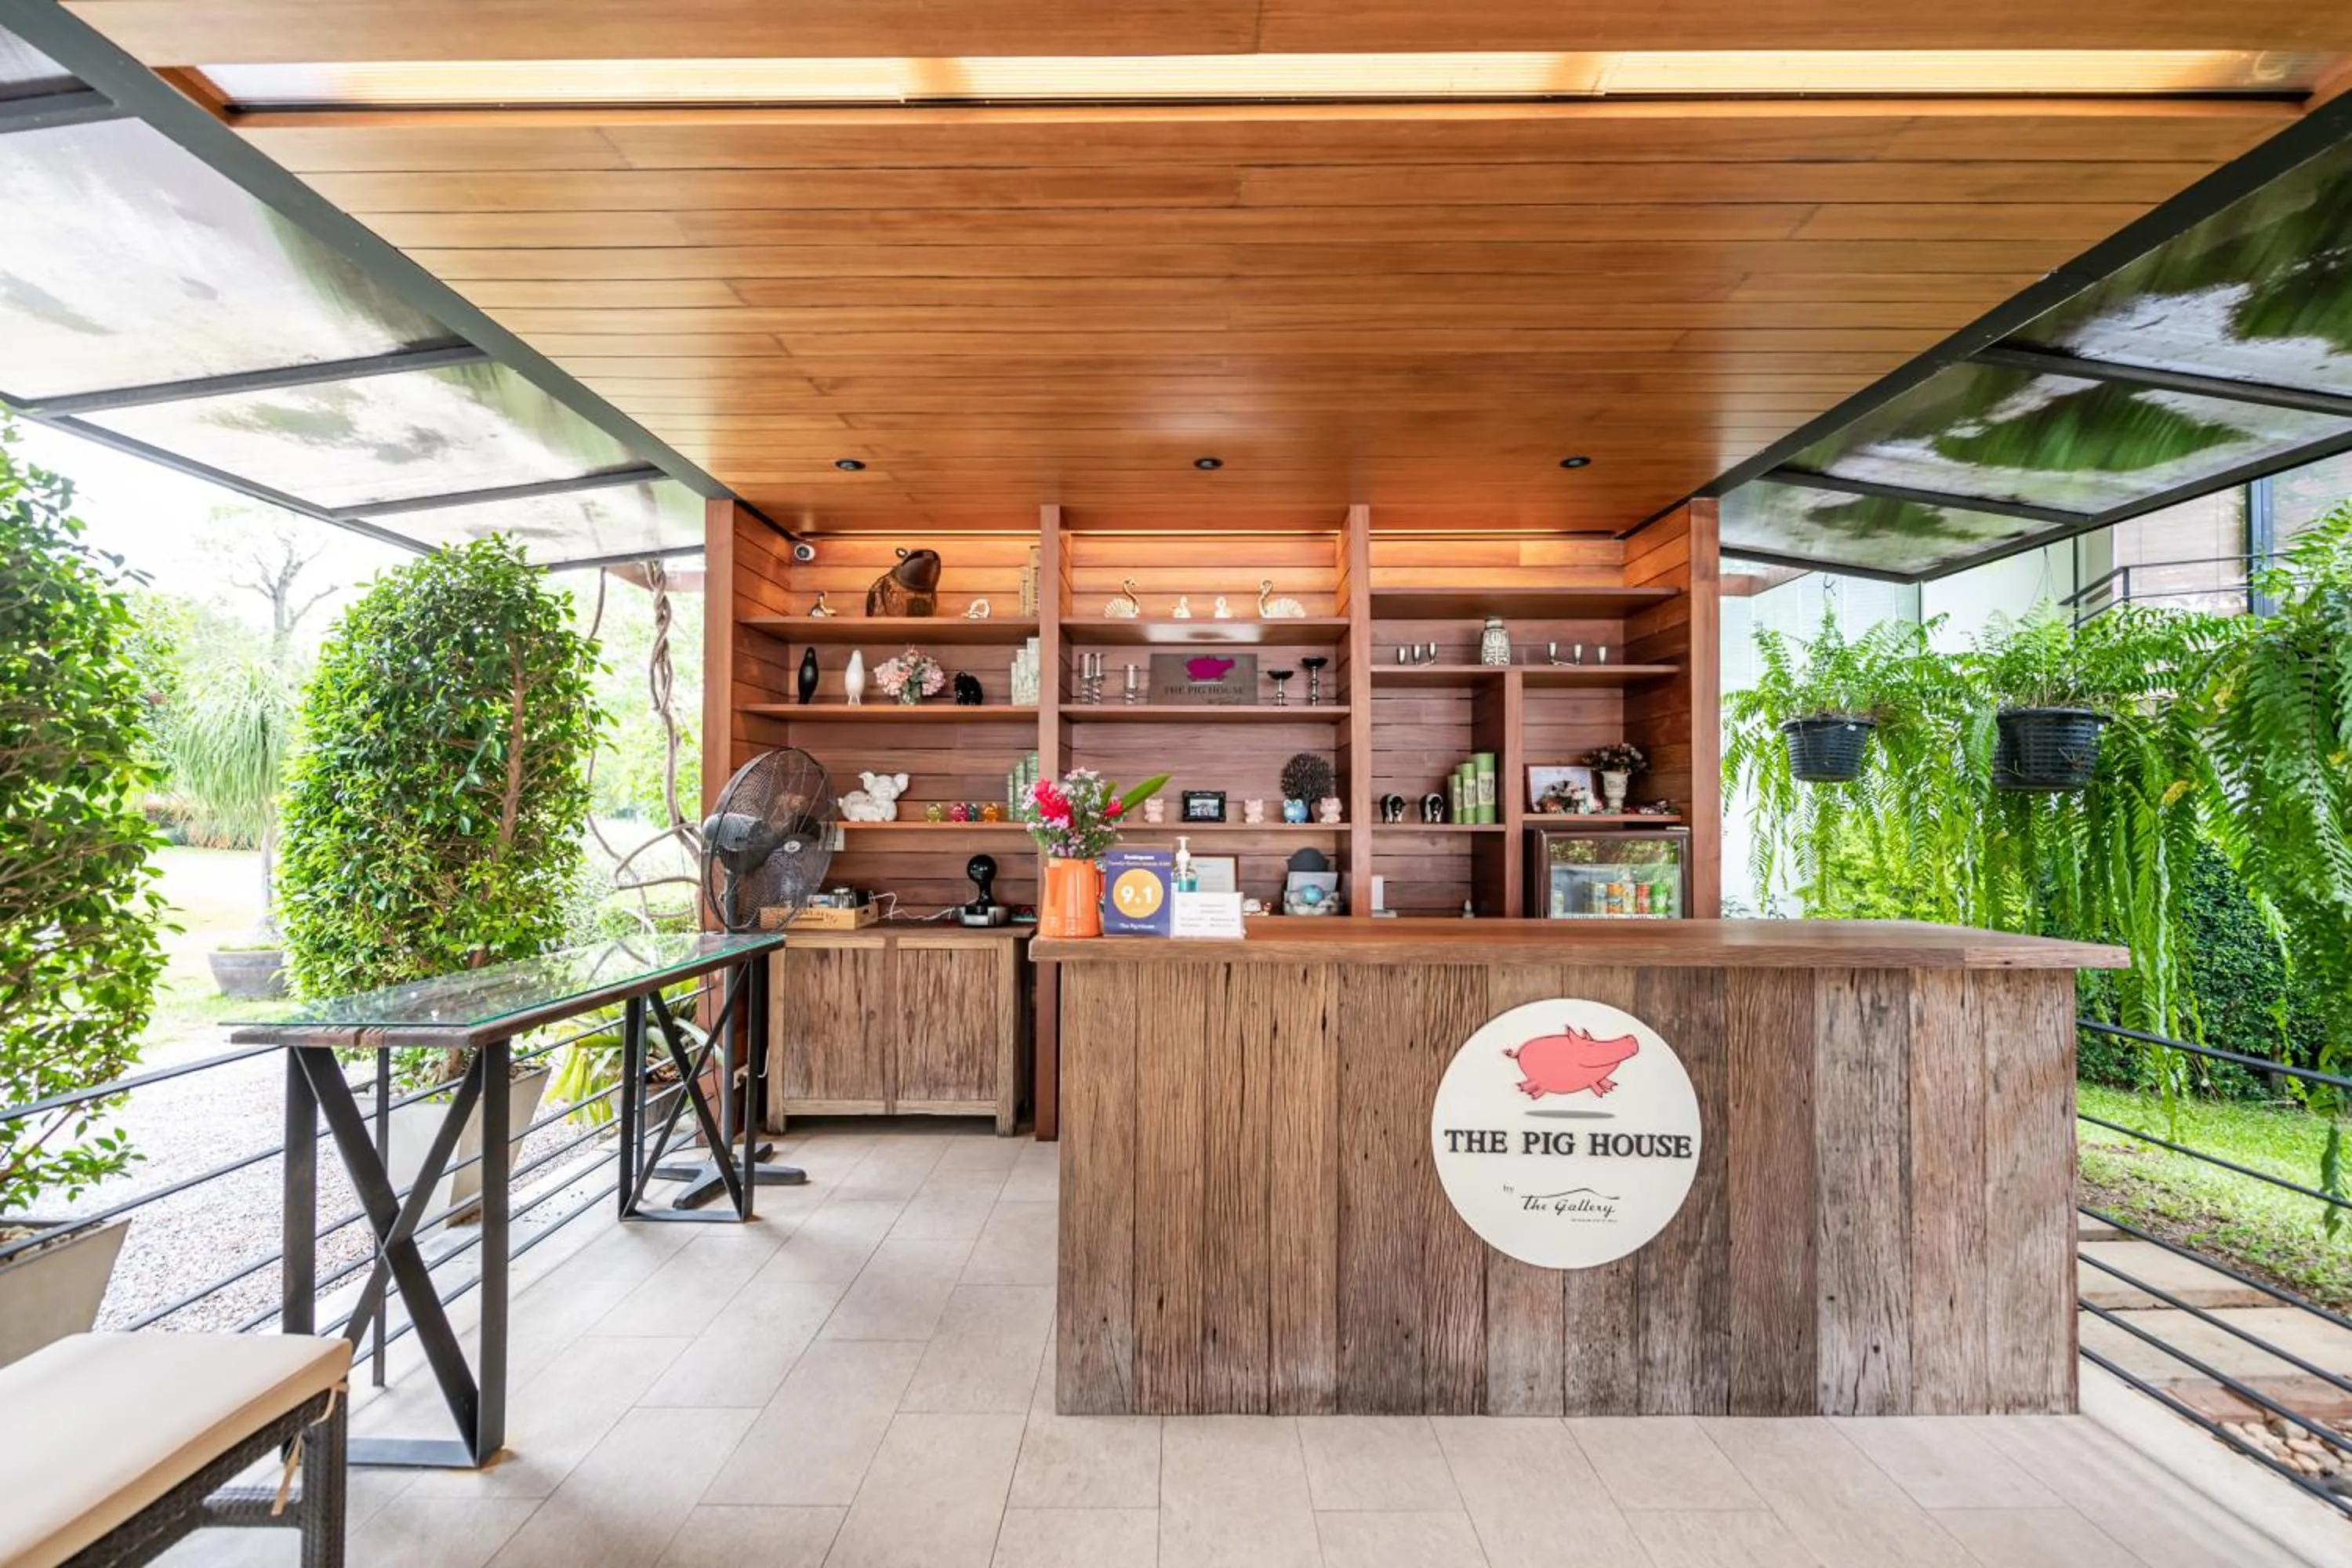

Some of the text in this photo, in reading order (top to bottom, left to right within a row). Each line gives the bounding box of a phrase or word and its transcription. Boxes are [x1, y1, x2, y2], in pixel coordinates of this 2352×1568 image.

[1163, 685, 1184, 695] THE
[1188, 685, 1206, 695] PIG
[1120, 885, 1152, 904] 9.1
[1444, 1129, 1693, 1159] THE PIG HOUSE
[1503, 1184, 1515, 1196] by
[1523, 1195, 1615, 1218] The Gallery
